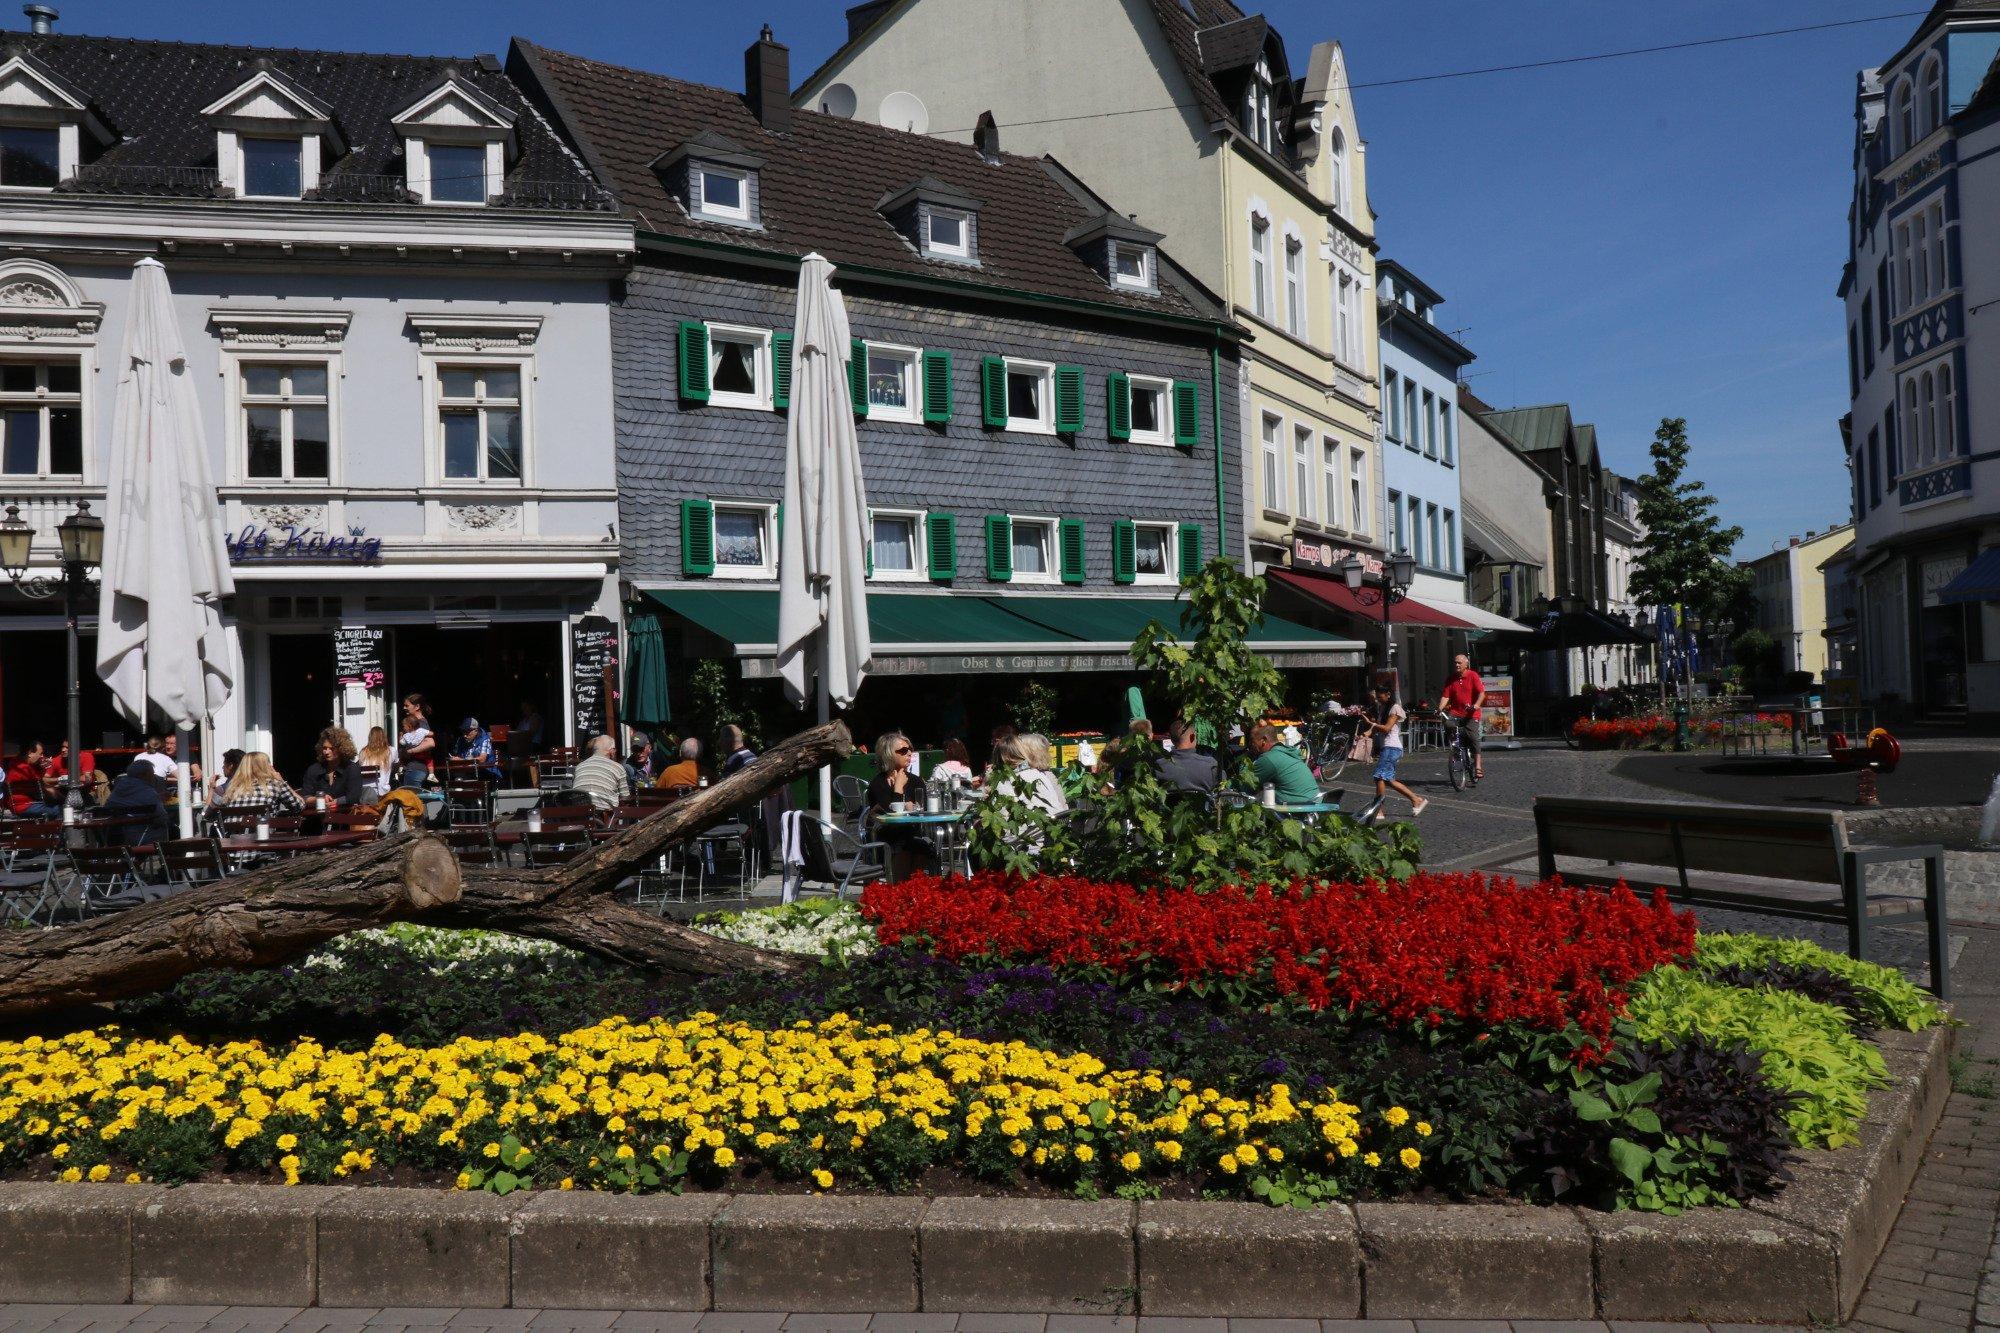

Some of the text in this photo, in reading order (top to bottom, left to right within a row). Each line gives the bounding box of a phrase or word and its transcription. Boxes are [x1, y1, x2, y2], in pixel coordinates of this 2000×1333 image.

[1295, 538, 1321, 565] Kamps
[961, 654, 1134, 670] Obst & Gemüse täglich frische
